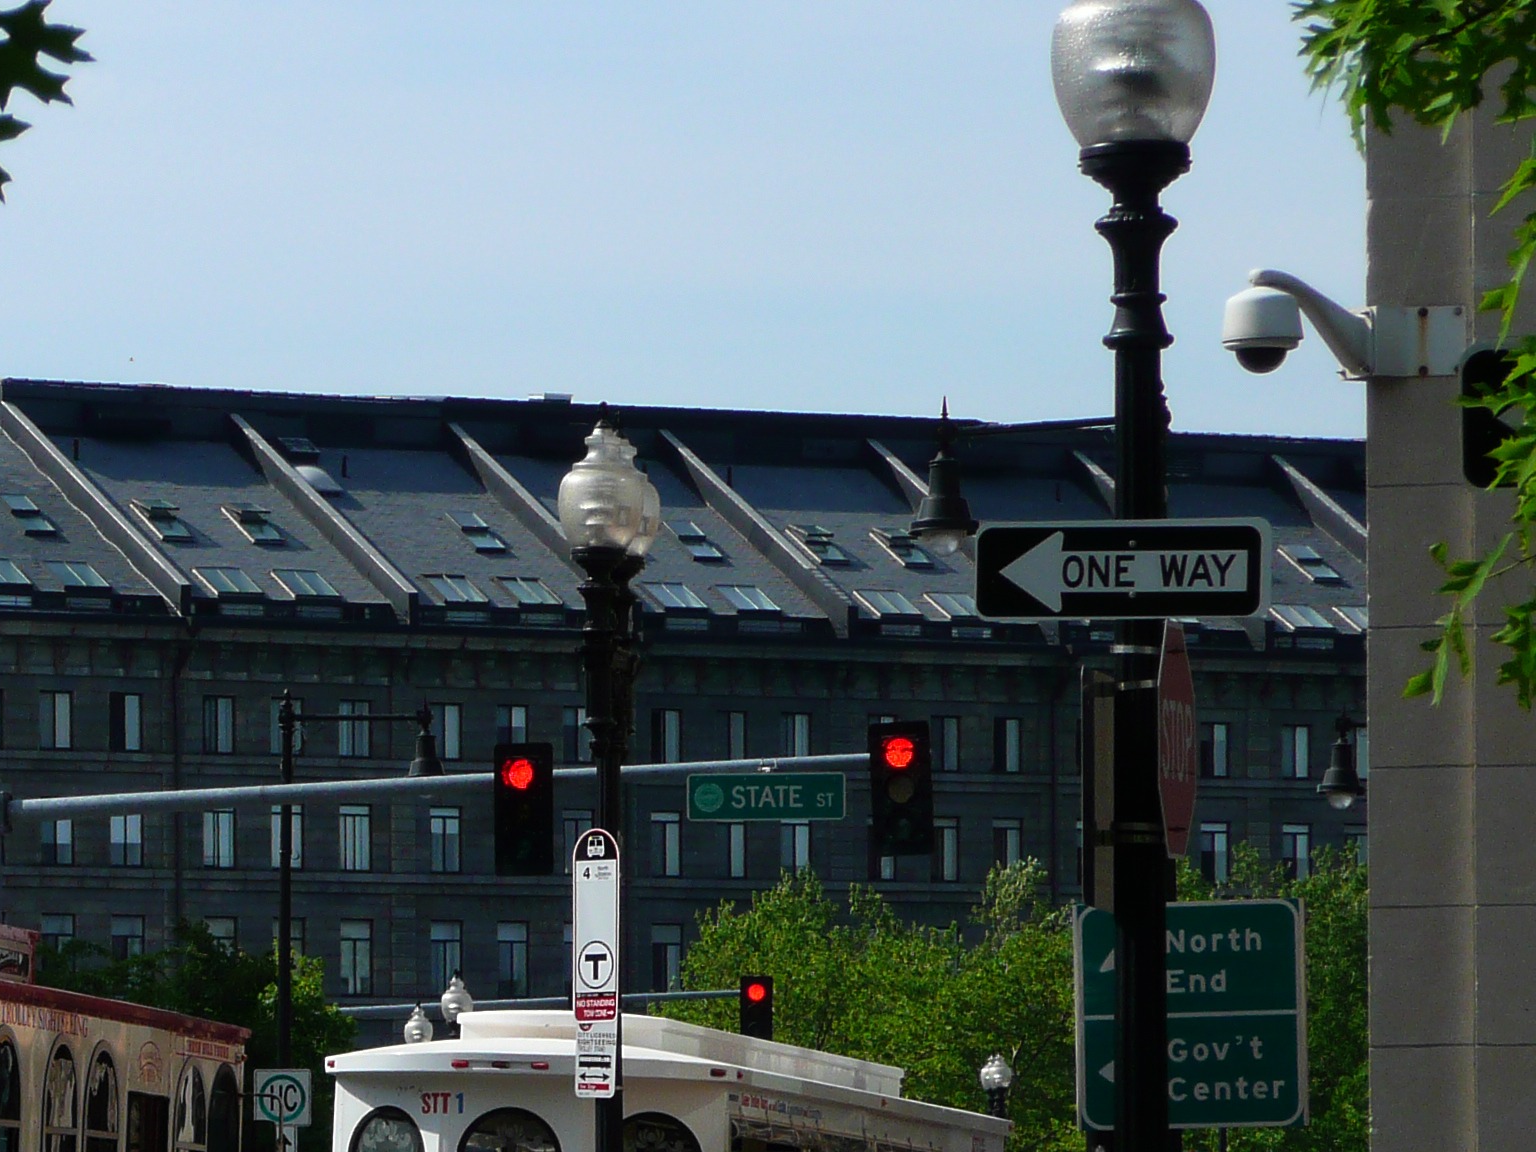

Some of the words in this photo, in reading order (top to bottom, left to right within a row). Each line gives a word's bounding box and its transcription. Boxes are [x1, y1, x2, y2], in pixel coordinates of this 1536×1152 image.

[1063, 554, 1136, 589] ONE
[1159, 553, 1237, 588] WAY
[1161, 697, 1194, 784] STOP
[731, 784, 804, 810] STATE
[816, 792, 835, 808] ST
[582, 866, 591, 880] 4
[1166, 927, 1263, 954] North
[1166, 969, 1227, 994] End
[576, 999, 586, 1008] NO
[586, 998, 615, 1008] STANDING
[1167, 1034, 1264, 1062] Gov't
[1167, 1076, 1286, 1102] Center
[421, 1092, 451, 1114] STT
[456, 1092, 465, 1114] 1
